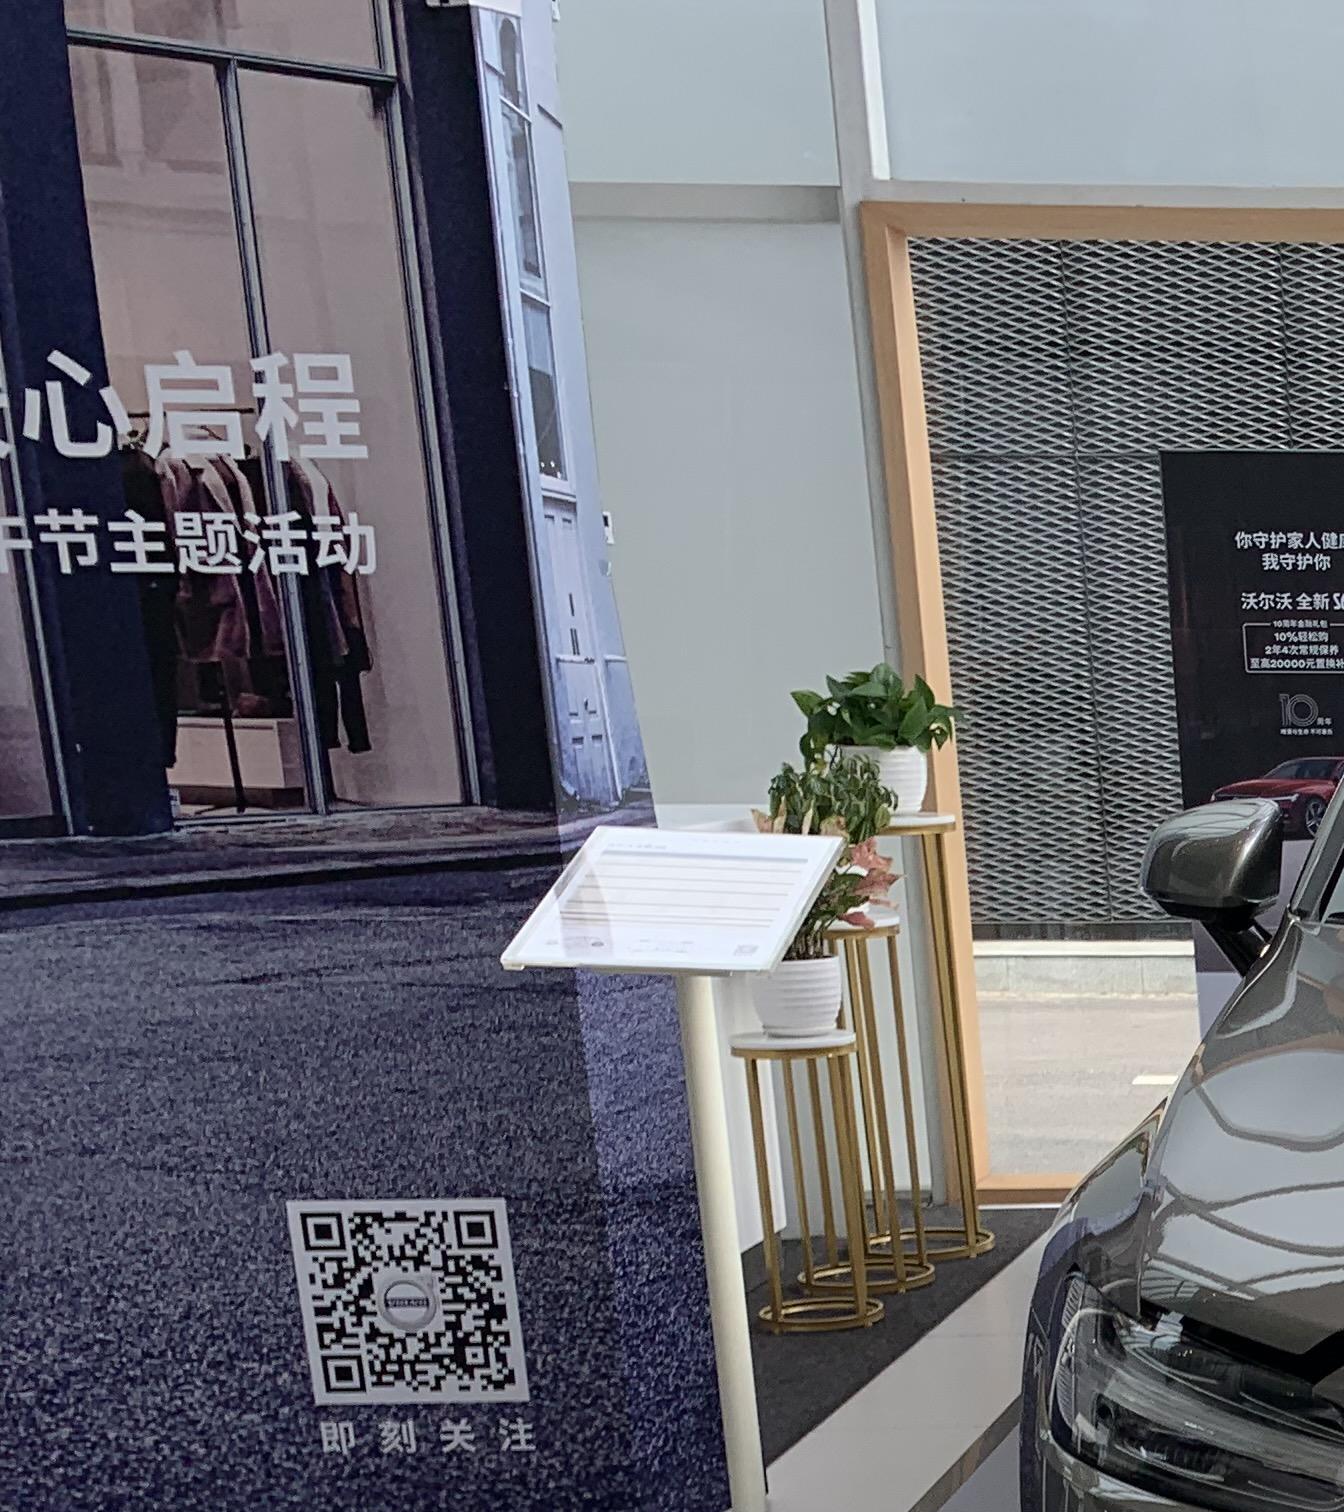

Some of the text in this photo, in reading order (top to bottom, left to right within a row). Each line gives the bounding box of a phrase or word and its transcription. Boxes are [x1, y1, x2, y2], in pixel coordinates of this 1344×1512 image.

[0, 350, 369, 462] 心启程
[1261, 553, 1331, 571] 我守护你
[1241, 592, 1293, 610] 沃尔沃
[1295, 592, 1330, 610] 全新
[1273, 631, 1329, 642] 10%轻松购
[319, 1417, 537, 1459] 即刻关注
